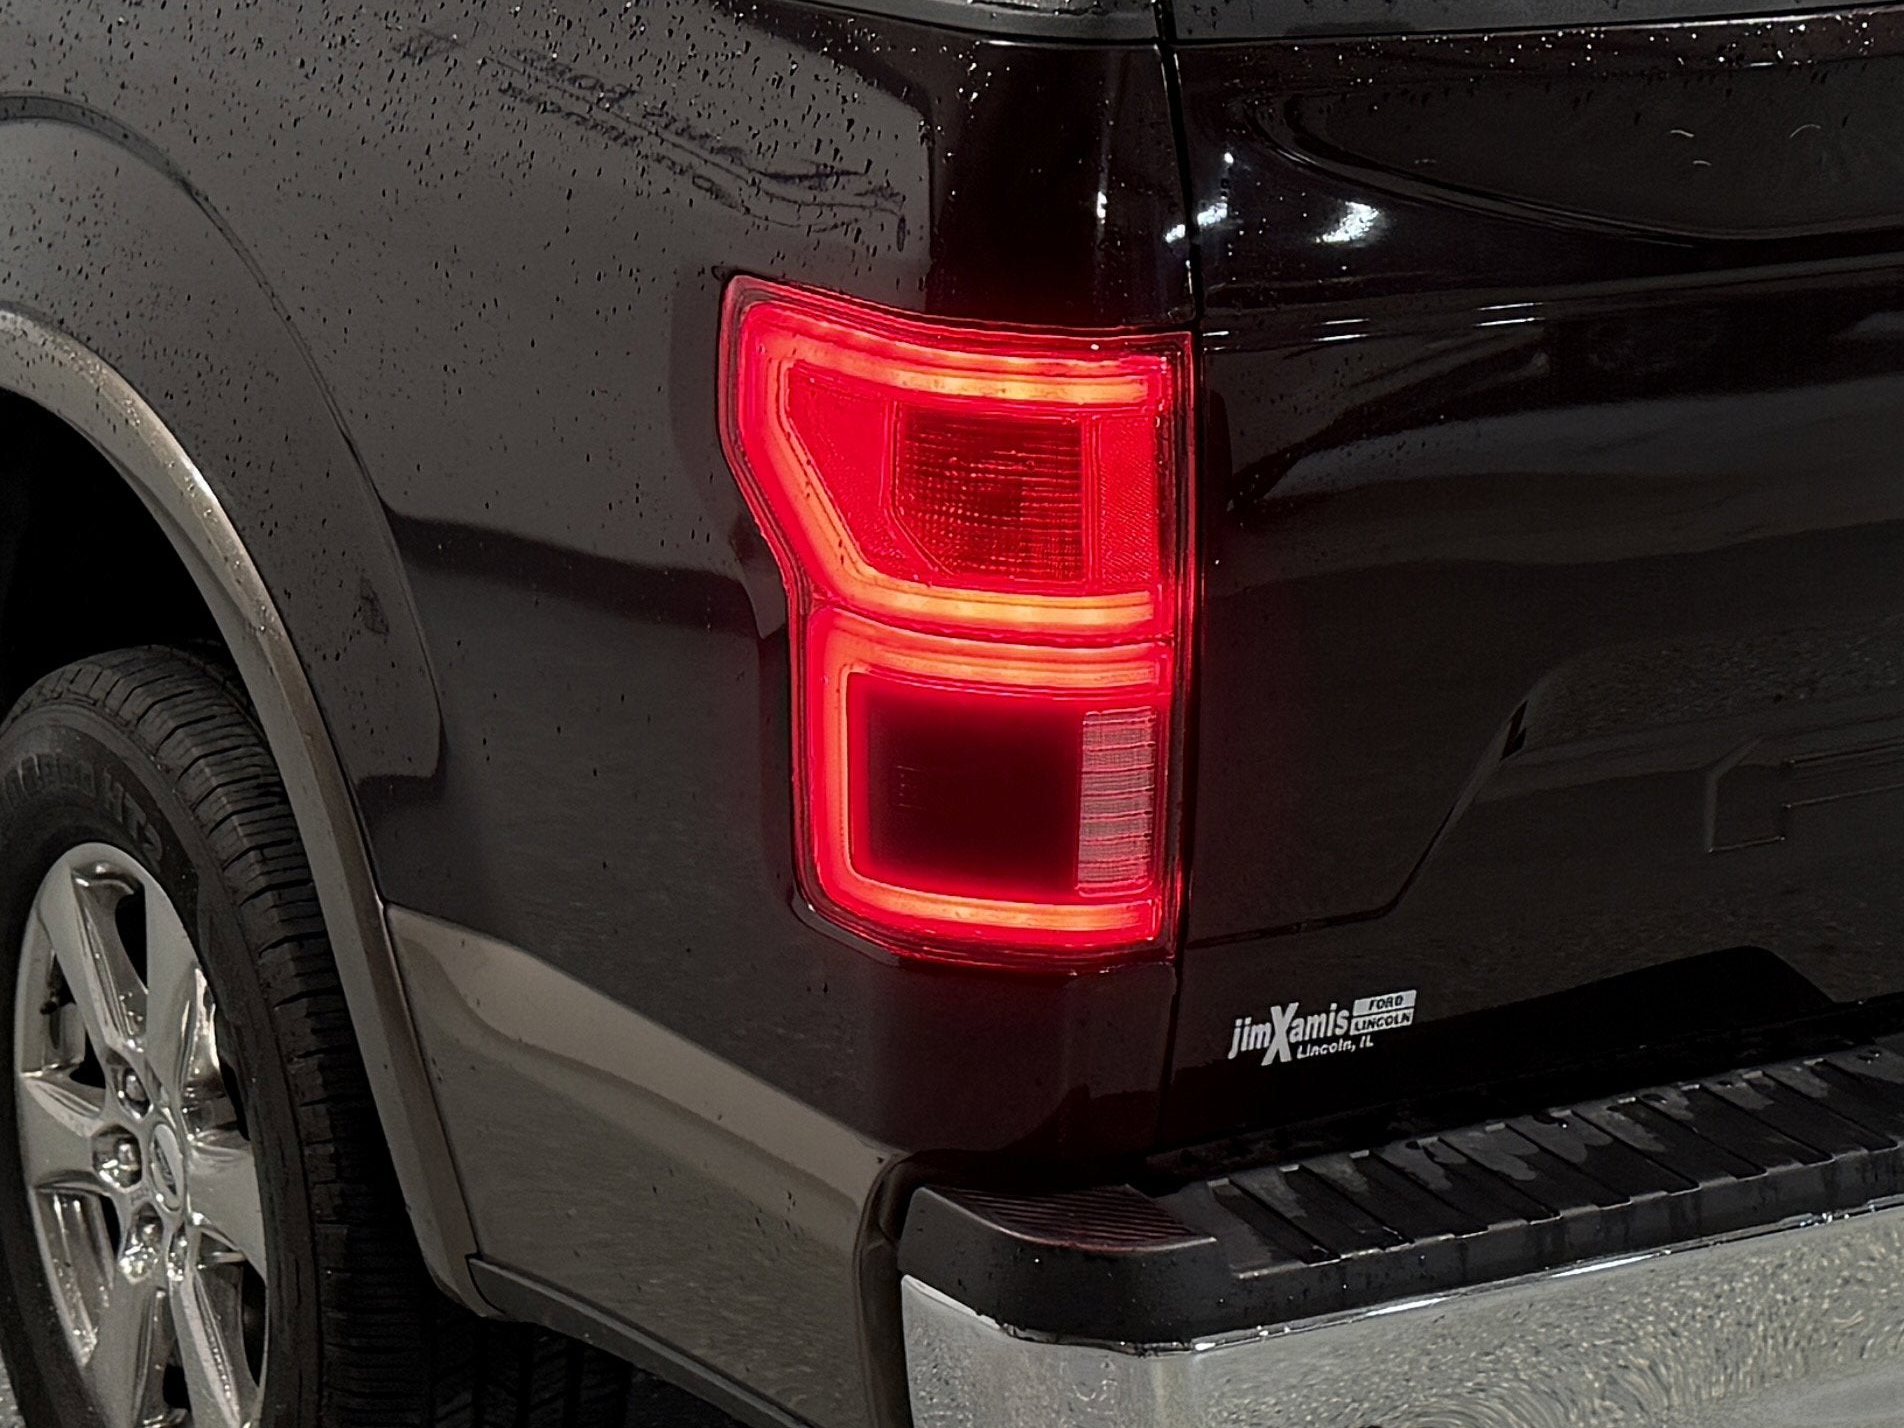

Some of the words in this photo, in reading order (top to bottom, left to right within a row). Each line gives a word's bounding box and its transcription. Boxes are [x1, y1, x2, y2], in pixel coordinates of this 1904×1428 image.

[1368, 994, 1404, 1011] FORD
[1354, 1012, 1411, 1032] LINCOLN
[1227, 1002, 1350, 1066] jimXamis
[1296, 1037, 1357, 1059] Lincoln,
[1359, 1035, 1374, 1048] IL
